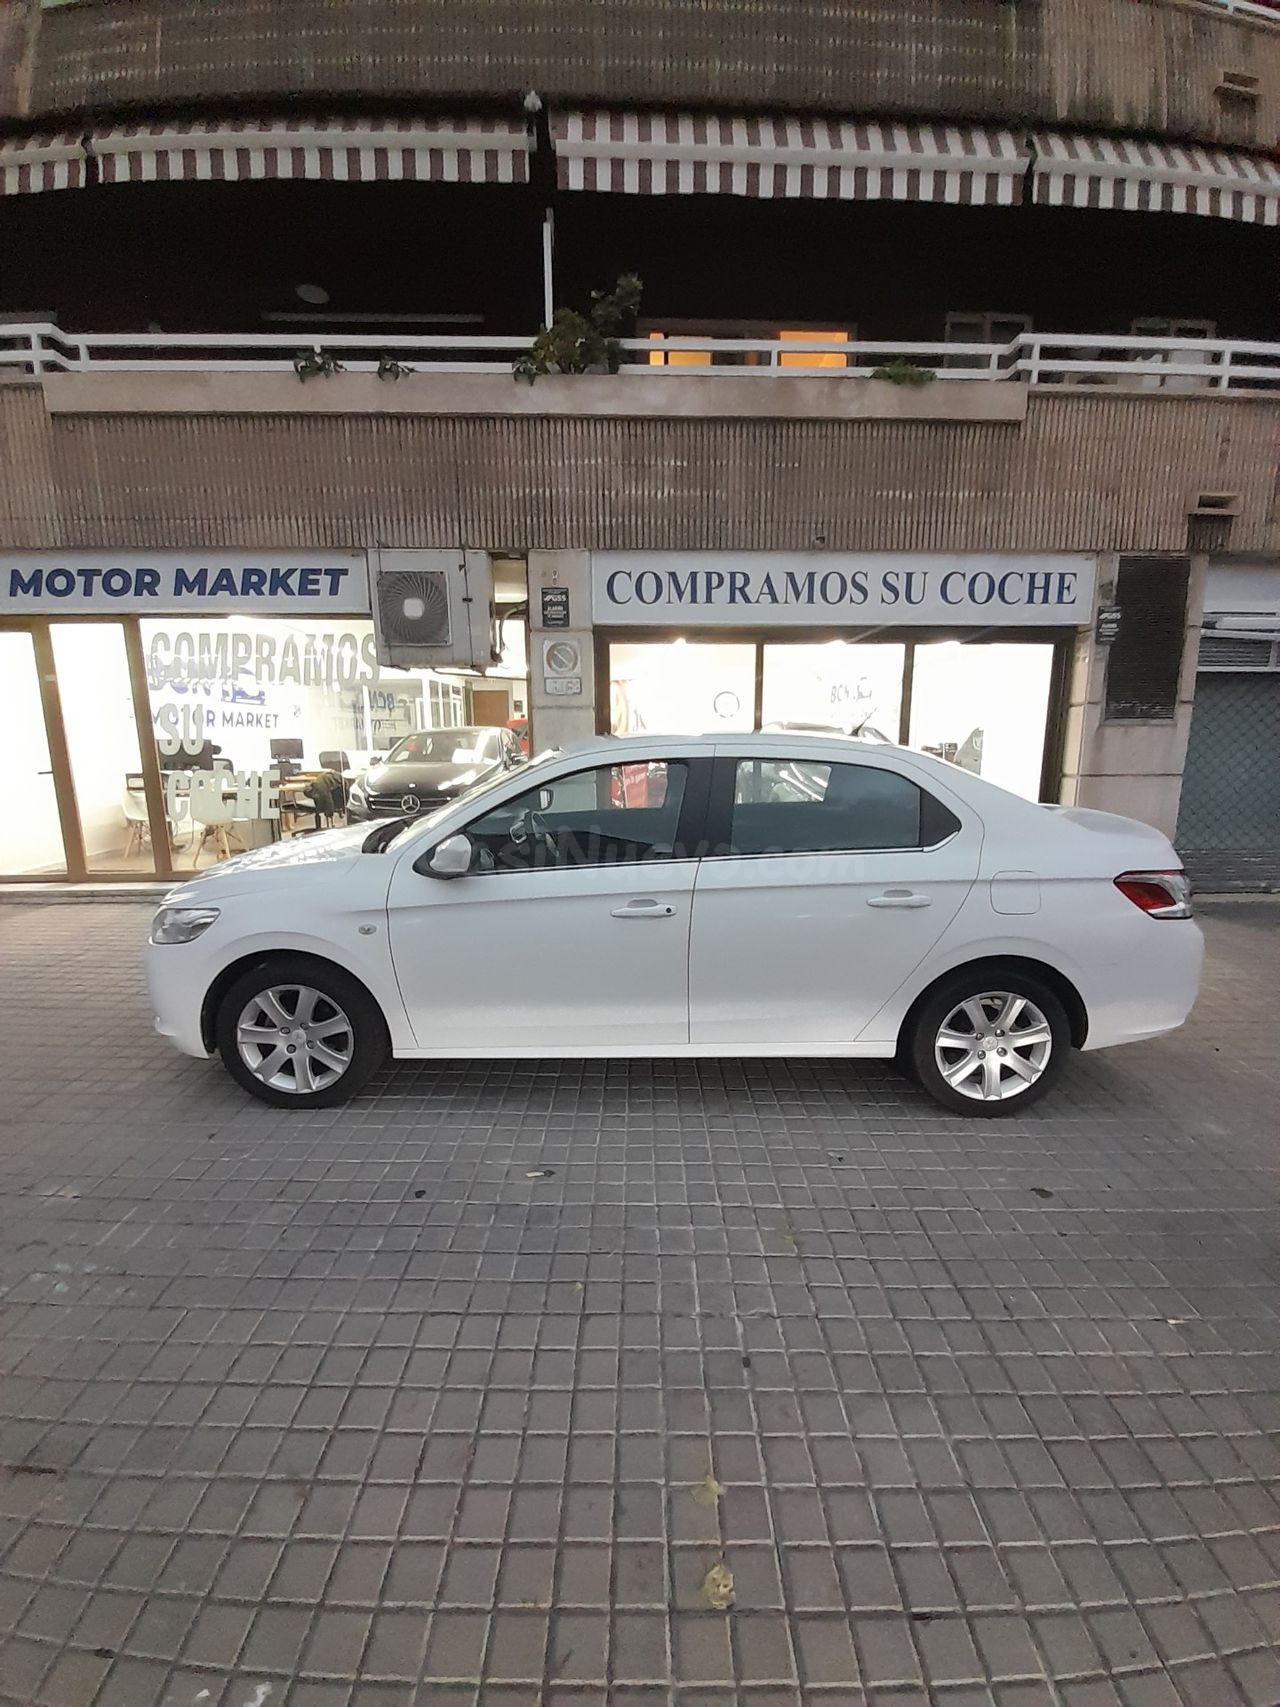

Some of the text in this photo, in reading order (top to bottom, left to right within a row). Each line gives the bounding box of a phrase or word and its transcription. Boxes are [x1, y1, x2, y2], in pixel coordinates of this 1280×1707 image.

[9, 568, 349, 597] MOTOR MARKET
[606, 570, 1078, 606] COMPRAMOS SU COCHE
[151, 632, 381, 687] COMPRAMOS
[159, 703, 204, 755] SU
[221, 711, 279, 729] MARKET
[167, 769, 281, 821] COCHE
